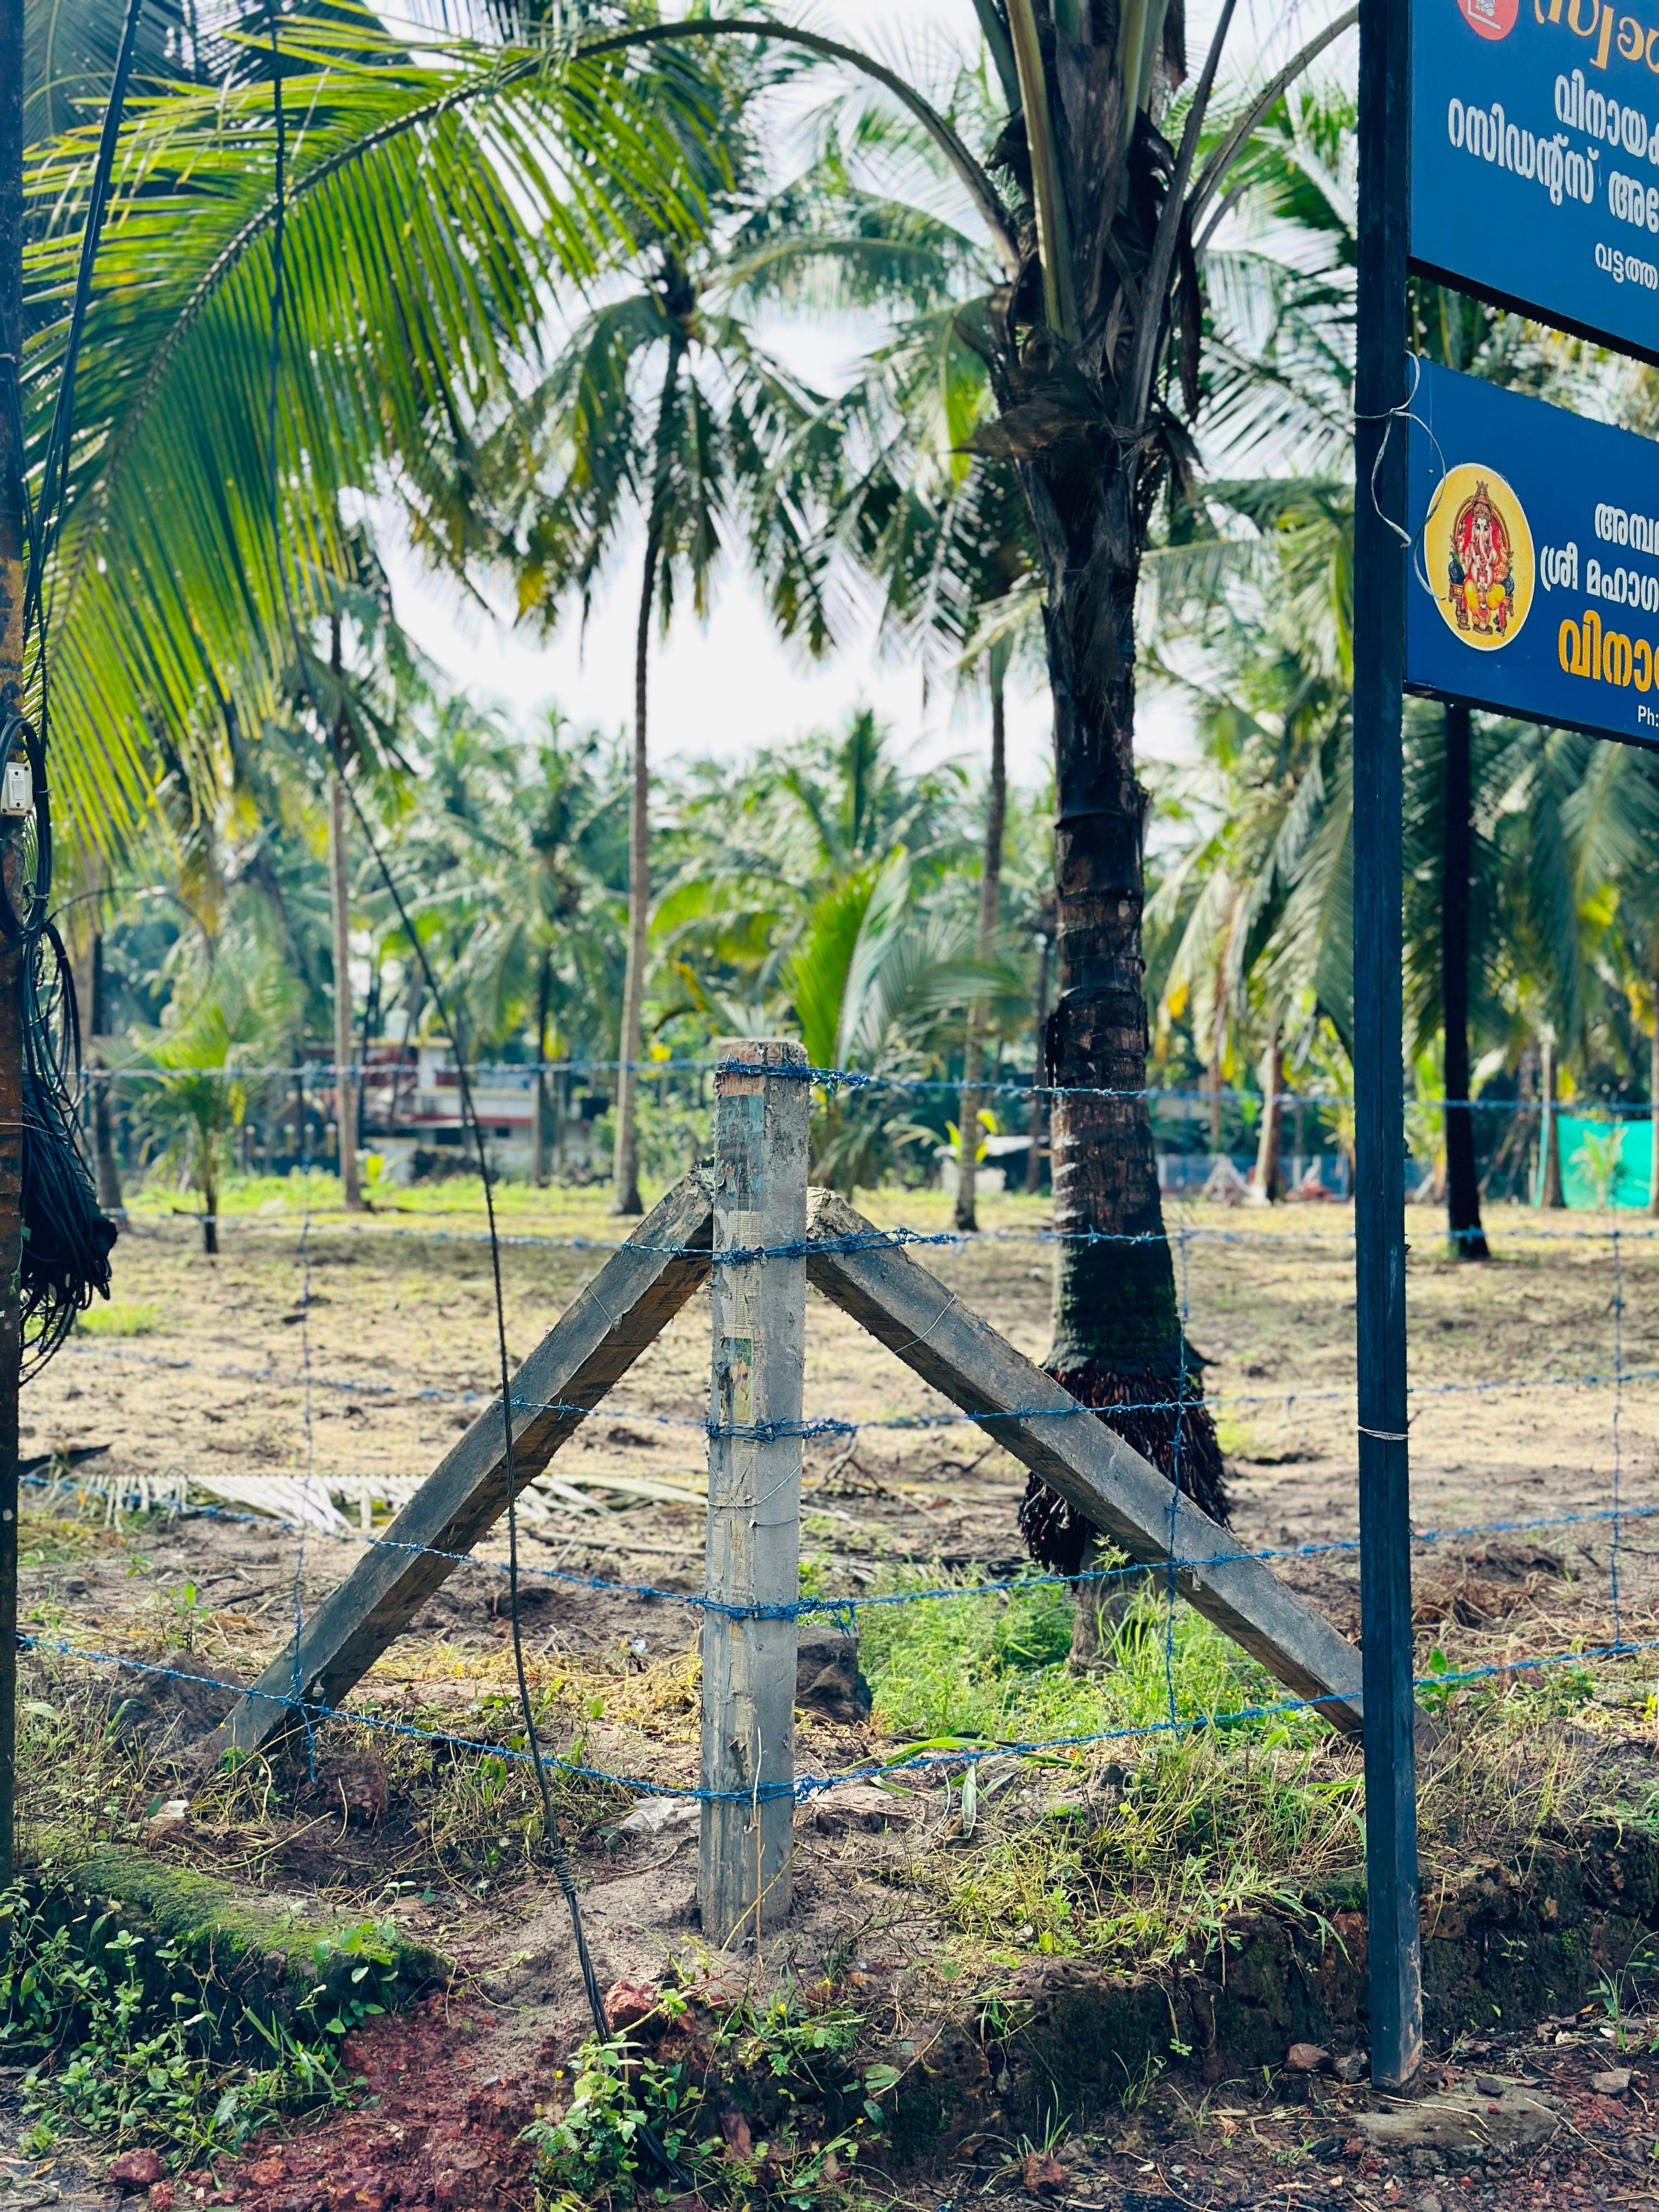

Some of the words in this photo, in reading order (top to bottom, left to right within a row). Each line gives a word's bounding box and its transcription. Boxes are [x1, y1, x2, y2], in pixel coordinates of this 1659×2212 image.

[1595, 503, 1659, 556] അമ്പ
[1540, 541, 1578, 591] ശ്രീ
[1558, 610, 1659, 692] വിനാ
